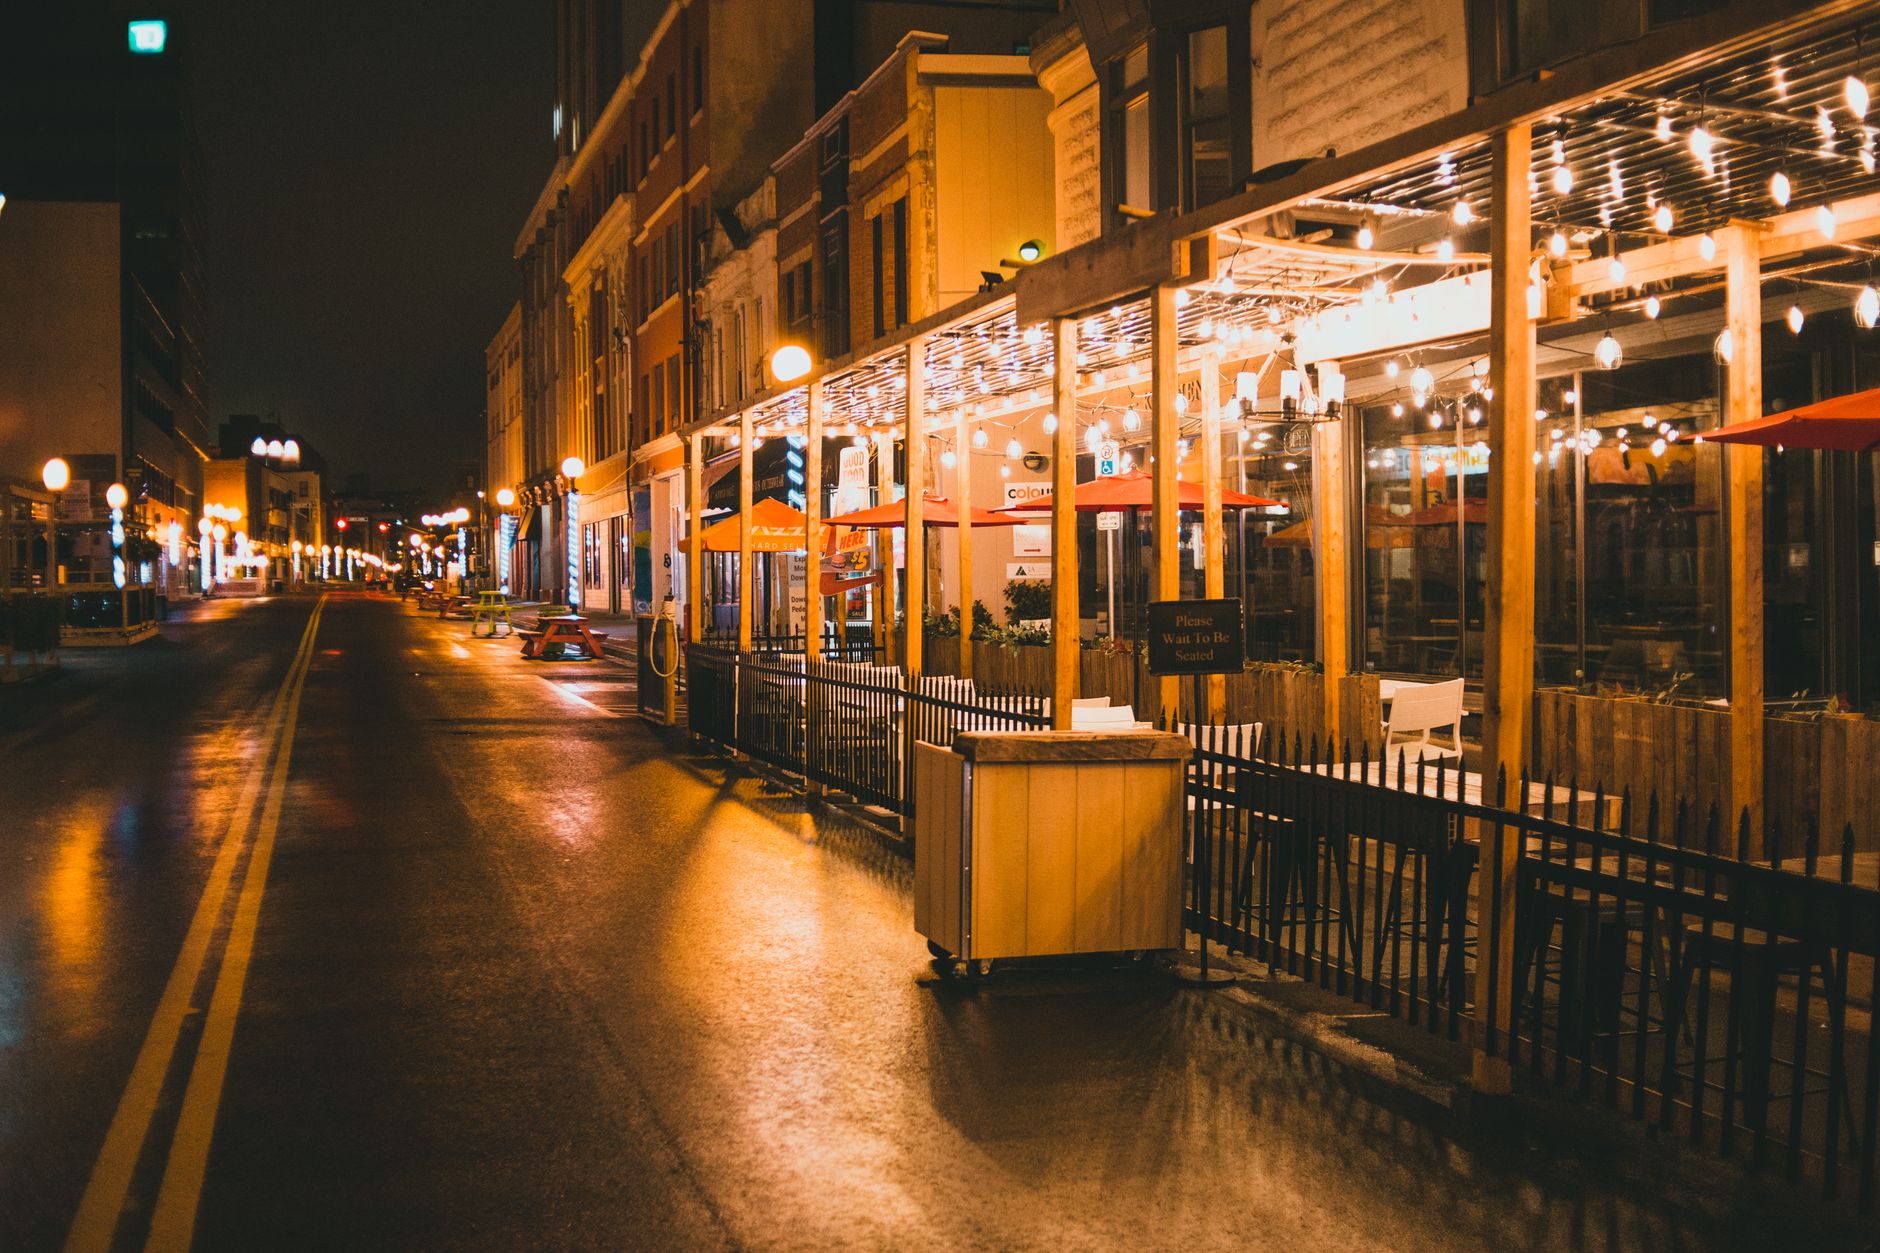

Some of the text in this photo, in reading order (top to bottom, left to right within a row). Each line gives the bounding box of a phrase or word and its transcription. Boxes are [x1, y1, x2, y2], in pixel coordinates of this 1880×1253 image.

[839, 531, 864, 550] HERE
[850, 551, 869, 570] $5
[1175, 615, 1213, 627] Please
[1162, 631, 1230, 644] Wait To Be
[1175, 649, 1214, 661] Seated
